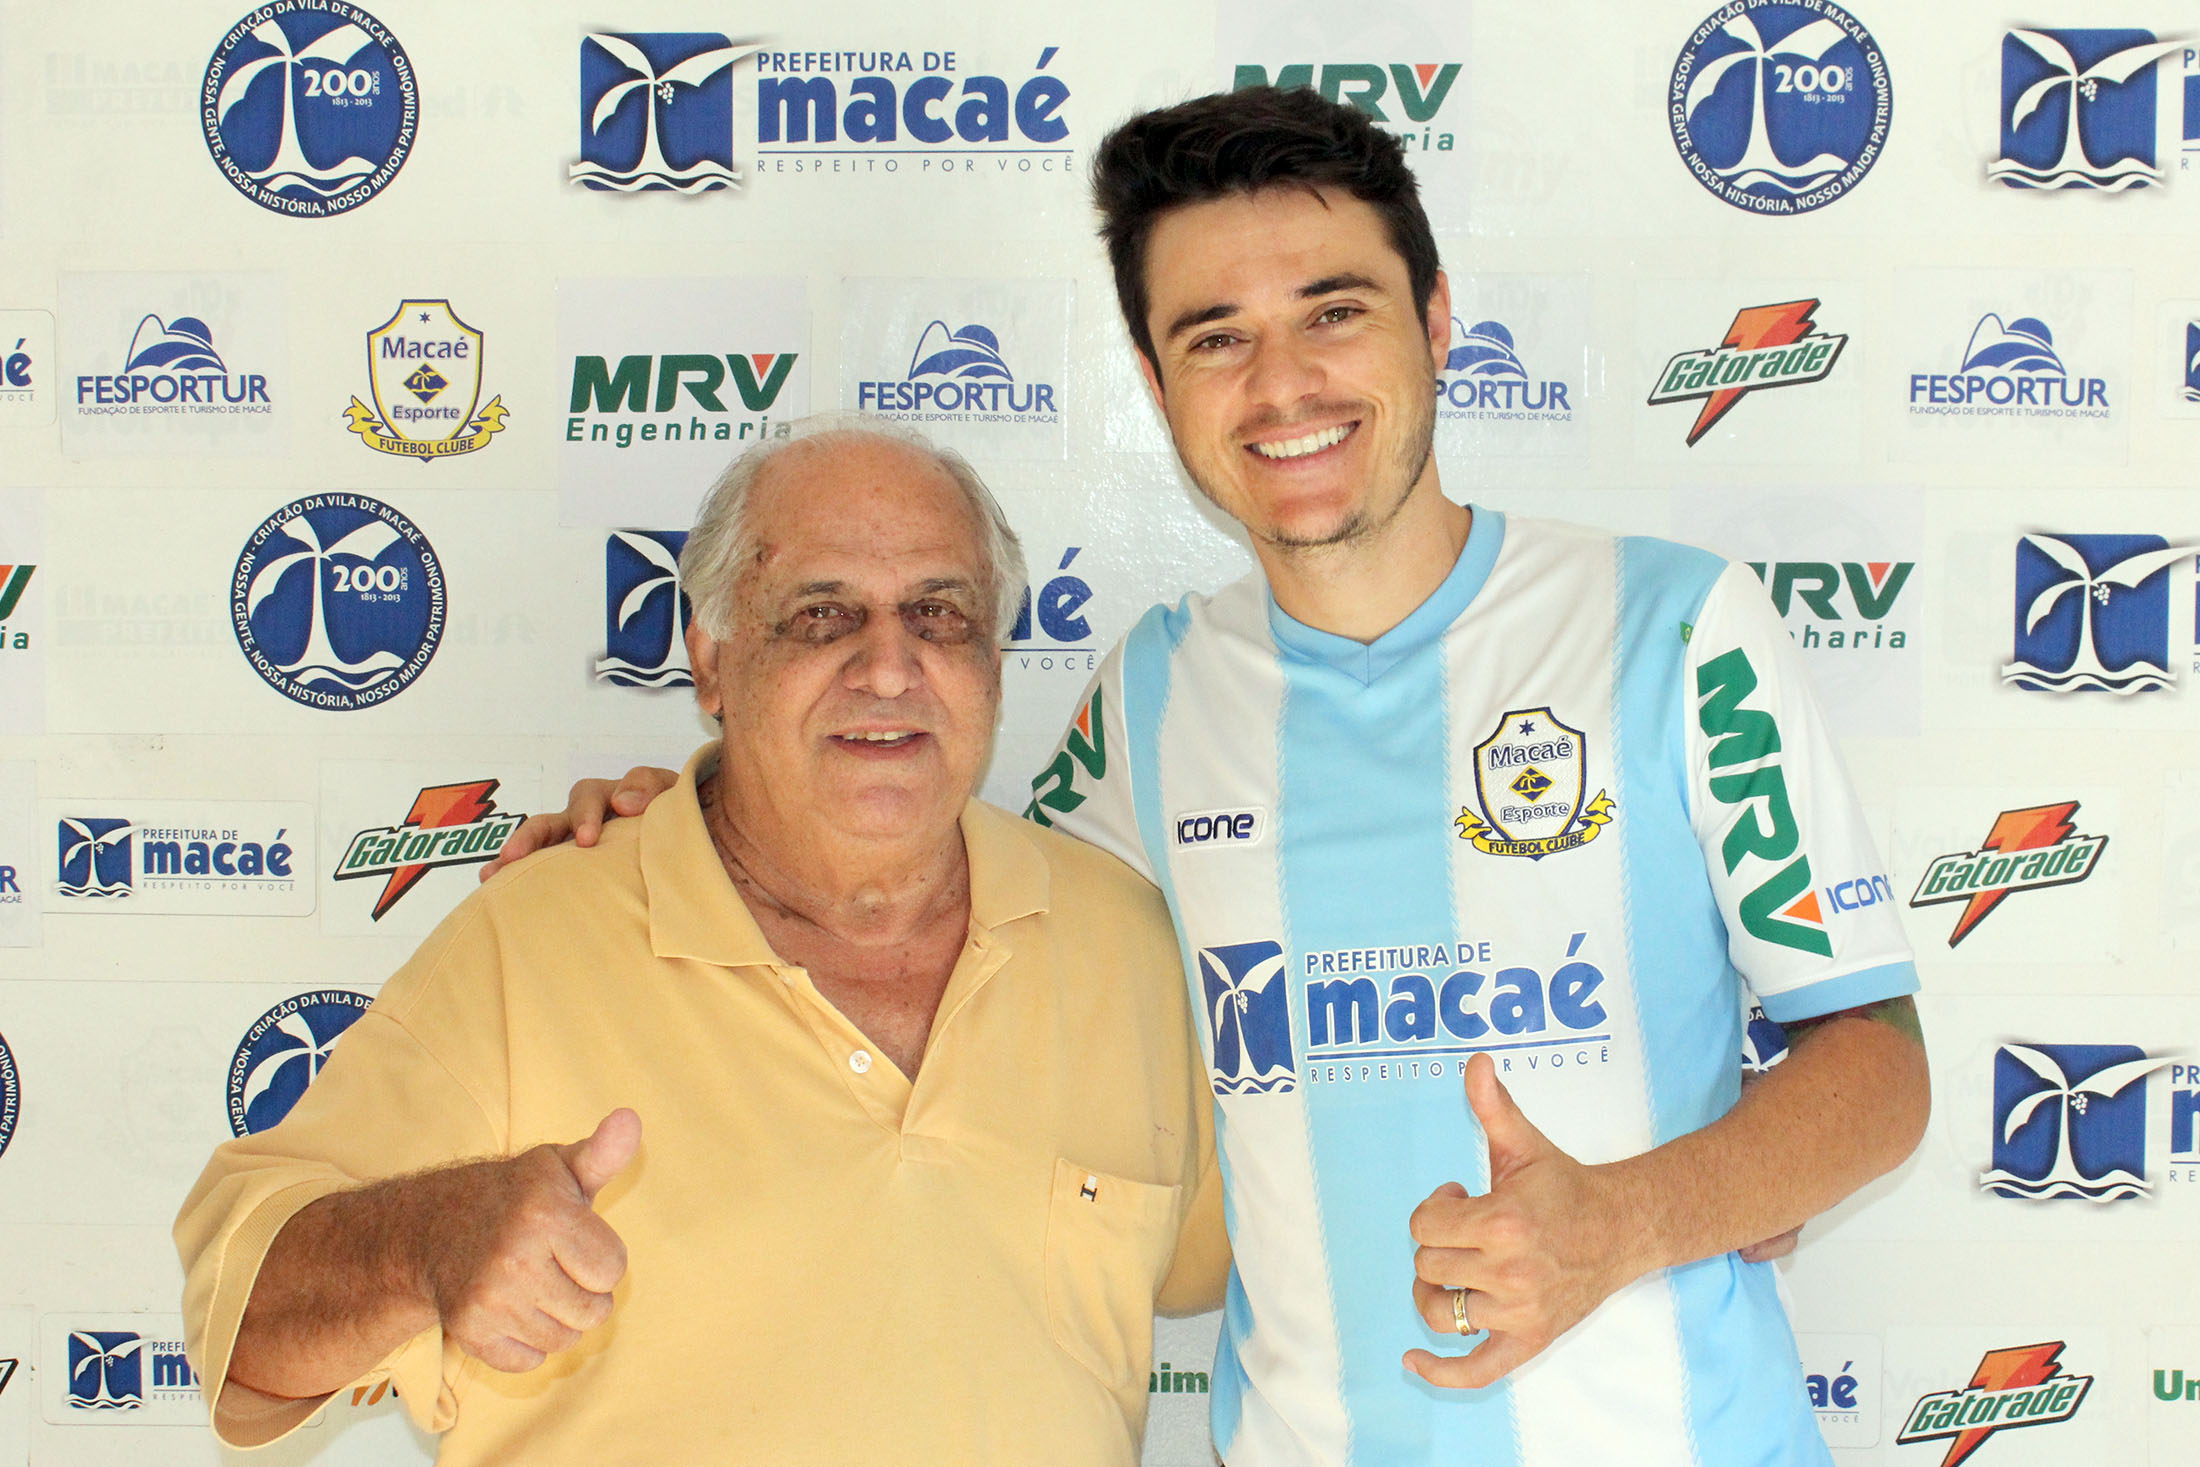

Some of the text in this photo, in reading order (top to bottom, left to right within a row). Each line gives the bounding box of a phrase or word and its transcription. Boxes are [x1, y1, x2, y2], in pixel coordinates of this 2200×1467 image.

[224, 0, 394, 50] CRIAÇÃO DA VILA DE MACAÉ
[1693, 1, 1746, 45] CRIAÇÃO
[1824, 4, 1868, 44] MACAÉ
[758, 52, 956, 72] PREFEITURA DE
[204, 58, 226, 106] NOSSA
[304, 69, 372, 97] 200
[1774, 64, 1846, 93] 200
[332, 98, 373, 108] 1813 2013
[392, 56, 416, 147] PATRIMÔNIO
[758, 46, 1072, 144] macaé
[1803, 94, 1845, 104] 1813 2013
[204, 108, 226, 159] GENTE,
[1672, 52, 1888, 214] NOSSA GENTE, NOSSA HISTÓRIA, NOSSO MAIOR PATRIMÔNIO
[221, 156, 258, 196] NOSSA
[370, 147, 406, 191] MAIOR
[758, 155, 1074, 173] RESPEITO POR VOCÊ
[258, 184, 326, 216] HISTÓRIA,
[328, 184, 372, 212] NOSSO
[382, 336, 469, 359] Macaé
[570, 353, 798, 413] MRV
[1660, 342, 1834, 394] Gatorade
[77, 374, 272, 404] FESPORTUR
[858, 382, 1058, 412] FESPORTUR
[1436, 378, 1571, 410] PORTUR
[1910, 374, 2110, 407] FESPORTUR
[78, 406, 128, 416] FUNDAÇÃO
[129, 406, 141, 414] DE
[143, 406, 180, 414] ESPORTE
[182, 406, 187, 414] E
[189, 406, 227, 414] TURISMO
[228, 406, 240, 414] DE
[392, 405, 460, 424] Esporte
[912, 414, 923, 422] DE
[925, 414, 963, 422] ESPORTE
[965, 414, 970, 422] E
[972, 414, 1012, 423] TURISMO
[1014, 415, 1026, 423] DE
[1440, 410, 1477, 420] ESPORTE
[1479, 412, 1484, 420] E
[1487, 412, 1526, 420] TURISMO
[1528, 412, 1539, 420] DE
[1910, 406, 1961, 417] FUNDAÇÃO
[1962, 408, 1975, 416] DE
[1977, 408, 2014, 416] ESPORTE
[2016, 408, 2022, 416] E
[2025, 408, 2064, 417] TURISMO
[2066, 409, 2078, 417] DE
[380, 438, 474, 454] FUTEBOL CLUBE
[566, 416, 792, 448] Engenharia
[254, 496, 422, 546] CRIAÇÃO DA VILA DE MACAÉ
[234, 553, 256, 600] NOSSA
[332, 565, 400, 592] 200
[1744, 562, 1916, 620] RV
[360, 594, 401, 604] 1813 2013
[421, 552, 443, 641] PATRIMÔNIO
[234, 602, 254, 652] GENTE,
[251, 650, 287, 690] NOSSA
[397, 642, 434, 684] MAIOR
[1020, 656, 1096, 670] VOCÊ
[288, 680, 354, 709] HISTÓRIA,
[356, 680, 400, 705] NOSSO
[1489, 736, 1572, 769] Macaé
[1501, 803, 1570, 824] Esporte
[1696, 647, 1834, 958] MRV
[143, 828, 238, 840] PREFEITURA DE
[346, 822, 514, 870] Gatorade
[1488, 832, 1586, 854] FUTEBOL CLUBE
[143, 828, 293, 877] macaé
[1922, 844, 2094, 896] Gatorade
[143, 882, 212, 890] RESPEITO
[222, 882, 248, 891] POR
[1306, 942, 1492, 974] PREFEITURA DE
[1307, 932, 1607, 1048] macaé
[250, 993, 372, 1042] CRIAÇÃO DA VILA DE
[231, 1048, 252, 1094] NOSSA
[1310, 1046, 1609, 1082] RESPEITO PR VOCÊ
[1908, 1382, 2078, 1433] Gatorade
